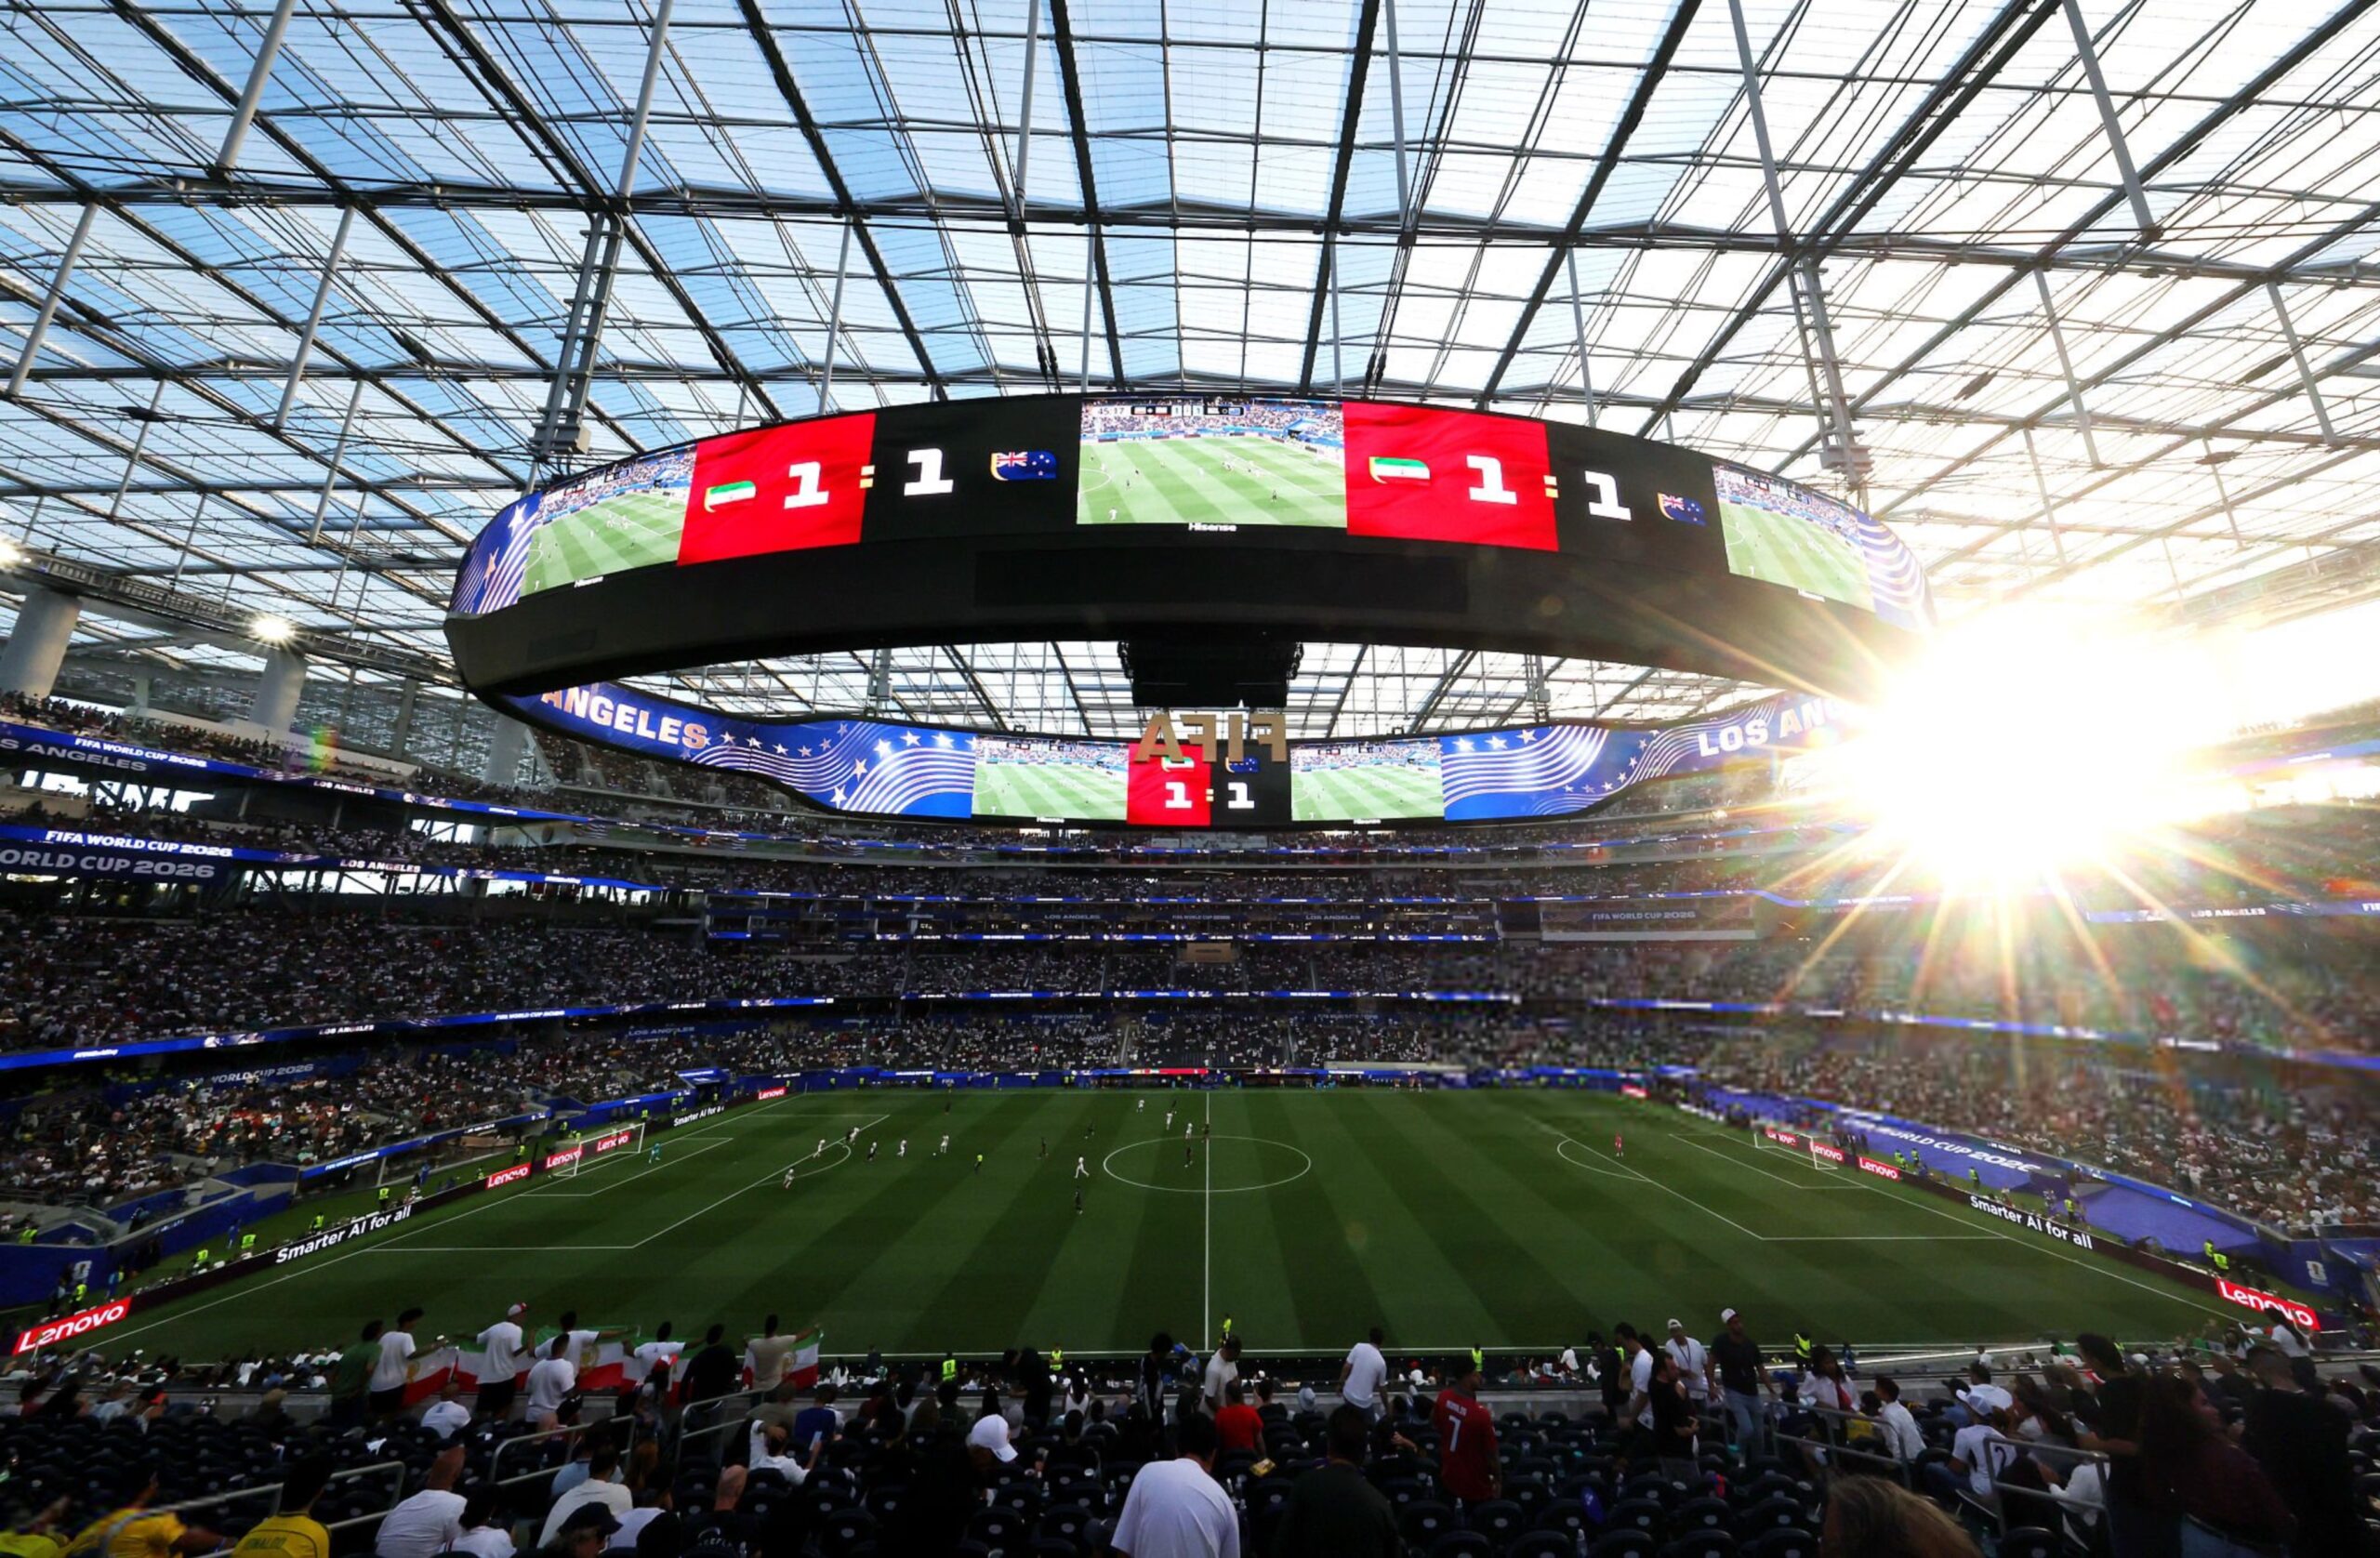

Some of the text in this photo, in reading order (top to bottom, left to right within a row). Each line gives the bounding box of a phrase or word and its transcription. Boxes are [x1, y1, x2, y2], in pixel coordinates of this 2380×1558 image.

[784, 461, 829, 509] 1
[904, 448, 954, 496] 1
[1466, 455, 1517, 505] 1
[1585, 470, 1632, 521] 1
[1188, 522, 1237, 532] Hisense
[541, 686, 708, 749] ANGELES
[74, 738, 101, 749] FIFA
[103, 744, 144, 757] WORLD
[145, 750, 169, 760] CUP
[1698, 719, 1769, 758] LOS
[26, 744, 147, 772] ANGELES
[1165, 782, 1193, 809] 1
[1227, 782, 1255, 809] 1
[46, 830, 232, 857] FIFA WORLD CUP 2026
[80, 856, 131, 872] CUP
[133, 861, 215, 878] 2026
[340, 859, 421, 873] LOS ANGELES
[597, 1133, 629, 1152] Lenovo
[1933, 1140, 1970, 1155] CUP
[487, 1167, 529, 1189] Lenovo
[1859, 1157, 1898, 1180] Lenovo
[275, 1206, 412, 1264] Smarter AI for all
[1970, 1195, 2093, 1249] Smarter AI for all
[18, 1304, 125, 1353] Lenovo
[1449, 1414, 1461, 1452] 7
